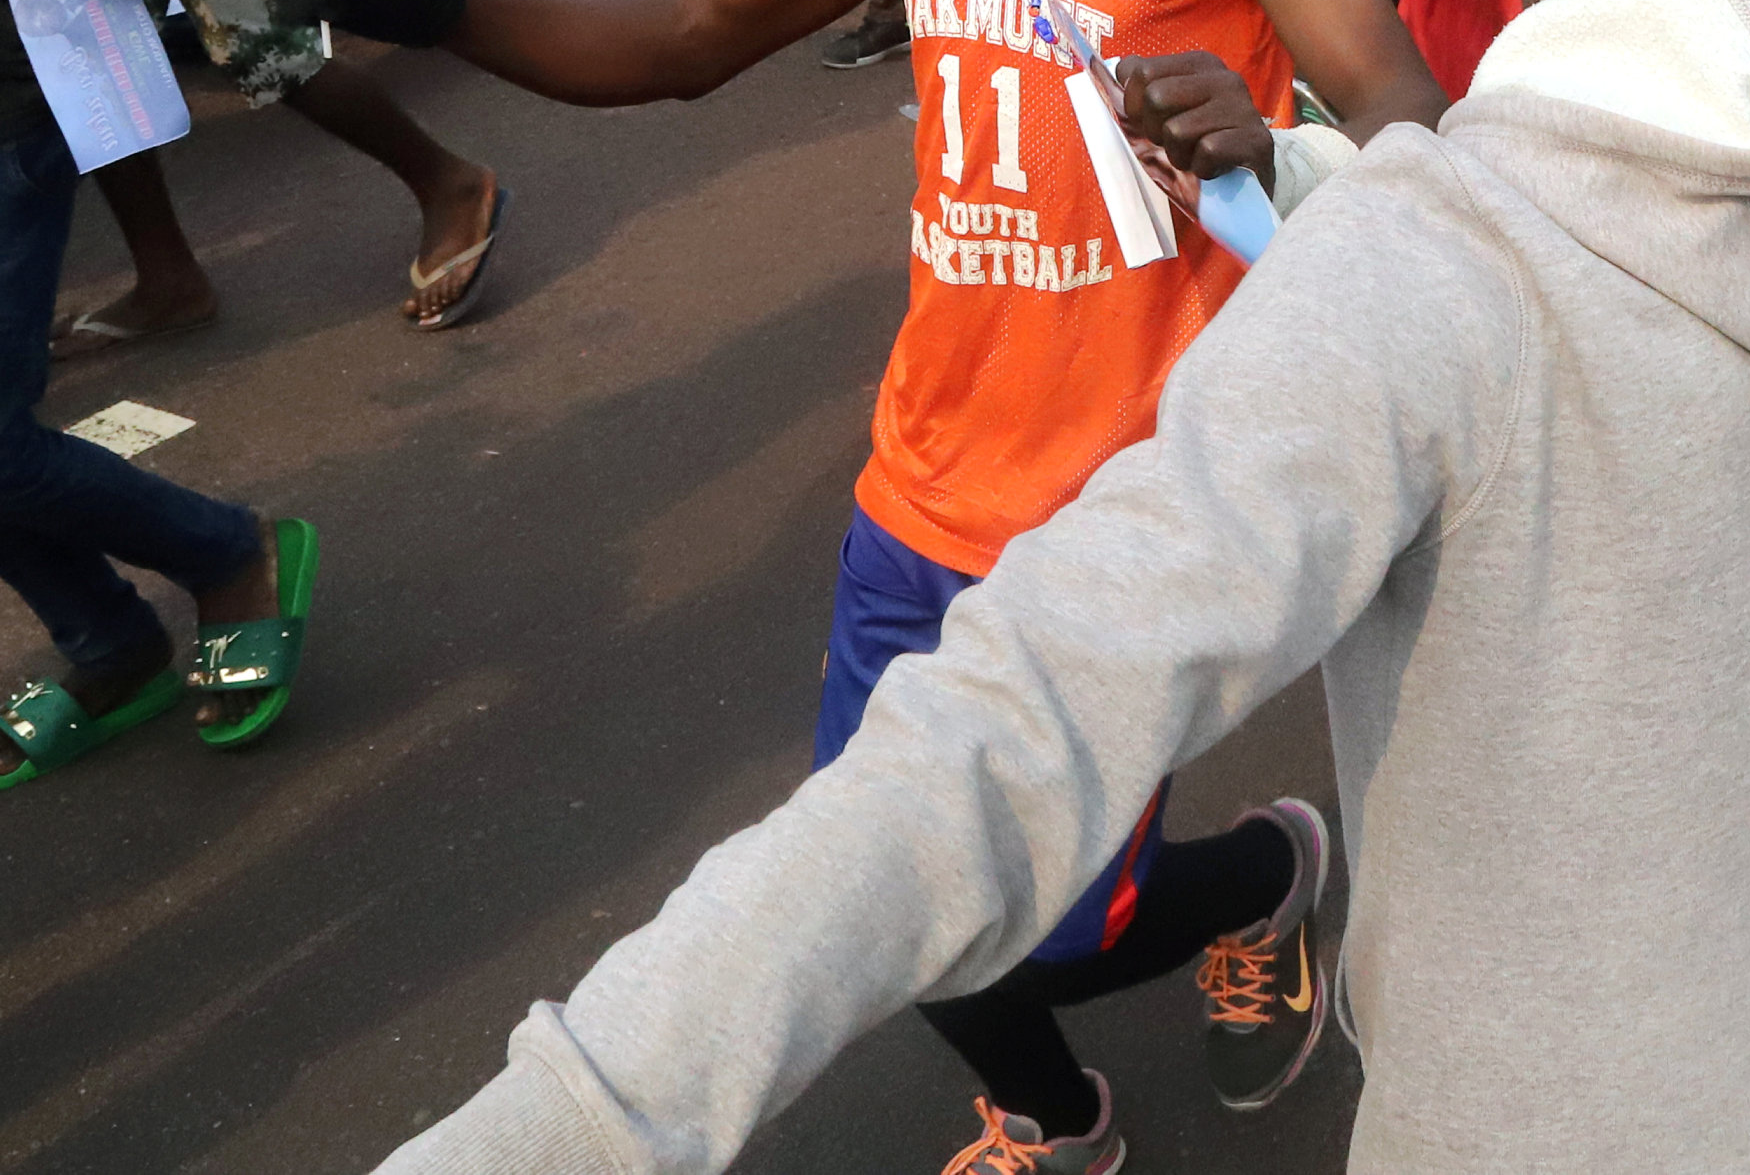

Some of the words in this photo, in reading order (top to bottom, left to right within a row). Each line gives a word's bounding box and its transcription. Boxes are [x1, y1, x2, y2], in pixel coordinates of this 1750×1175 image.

[937, 53, 1028, 194] 11
[911, 206, 1113, 293] ASKETBALL
[938, 191, 1039, 242] YOUTH
